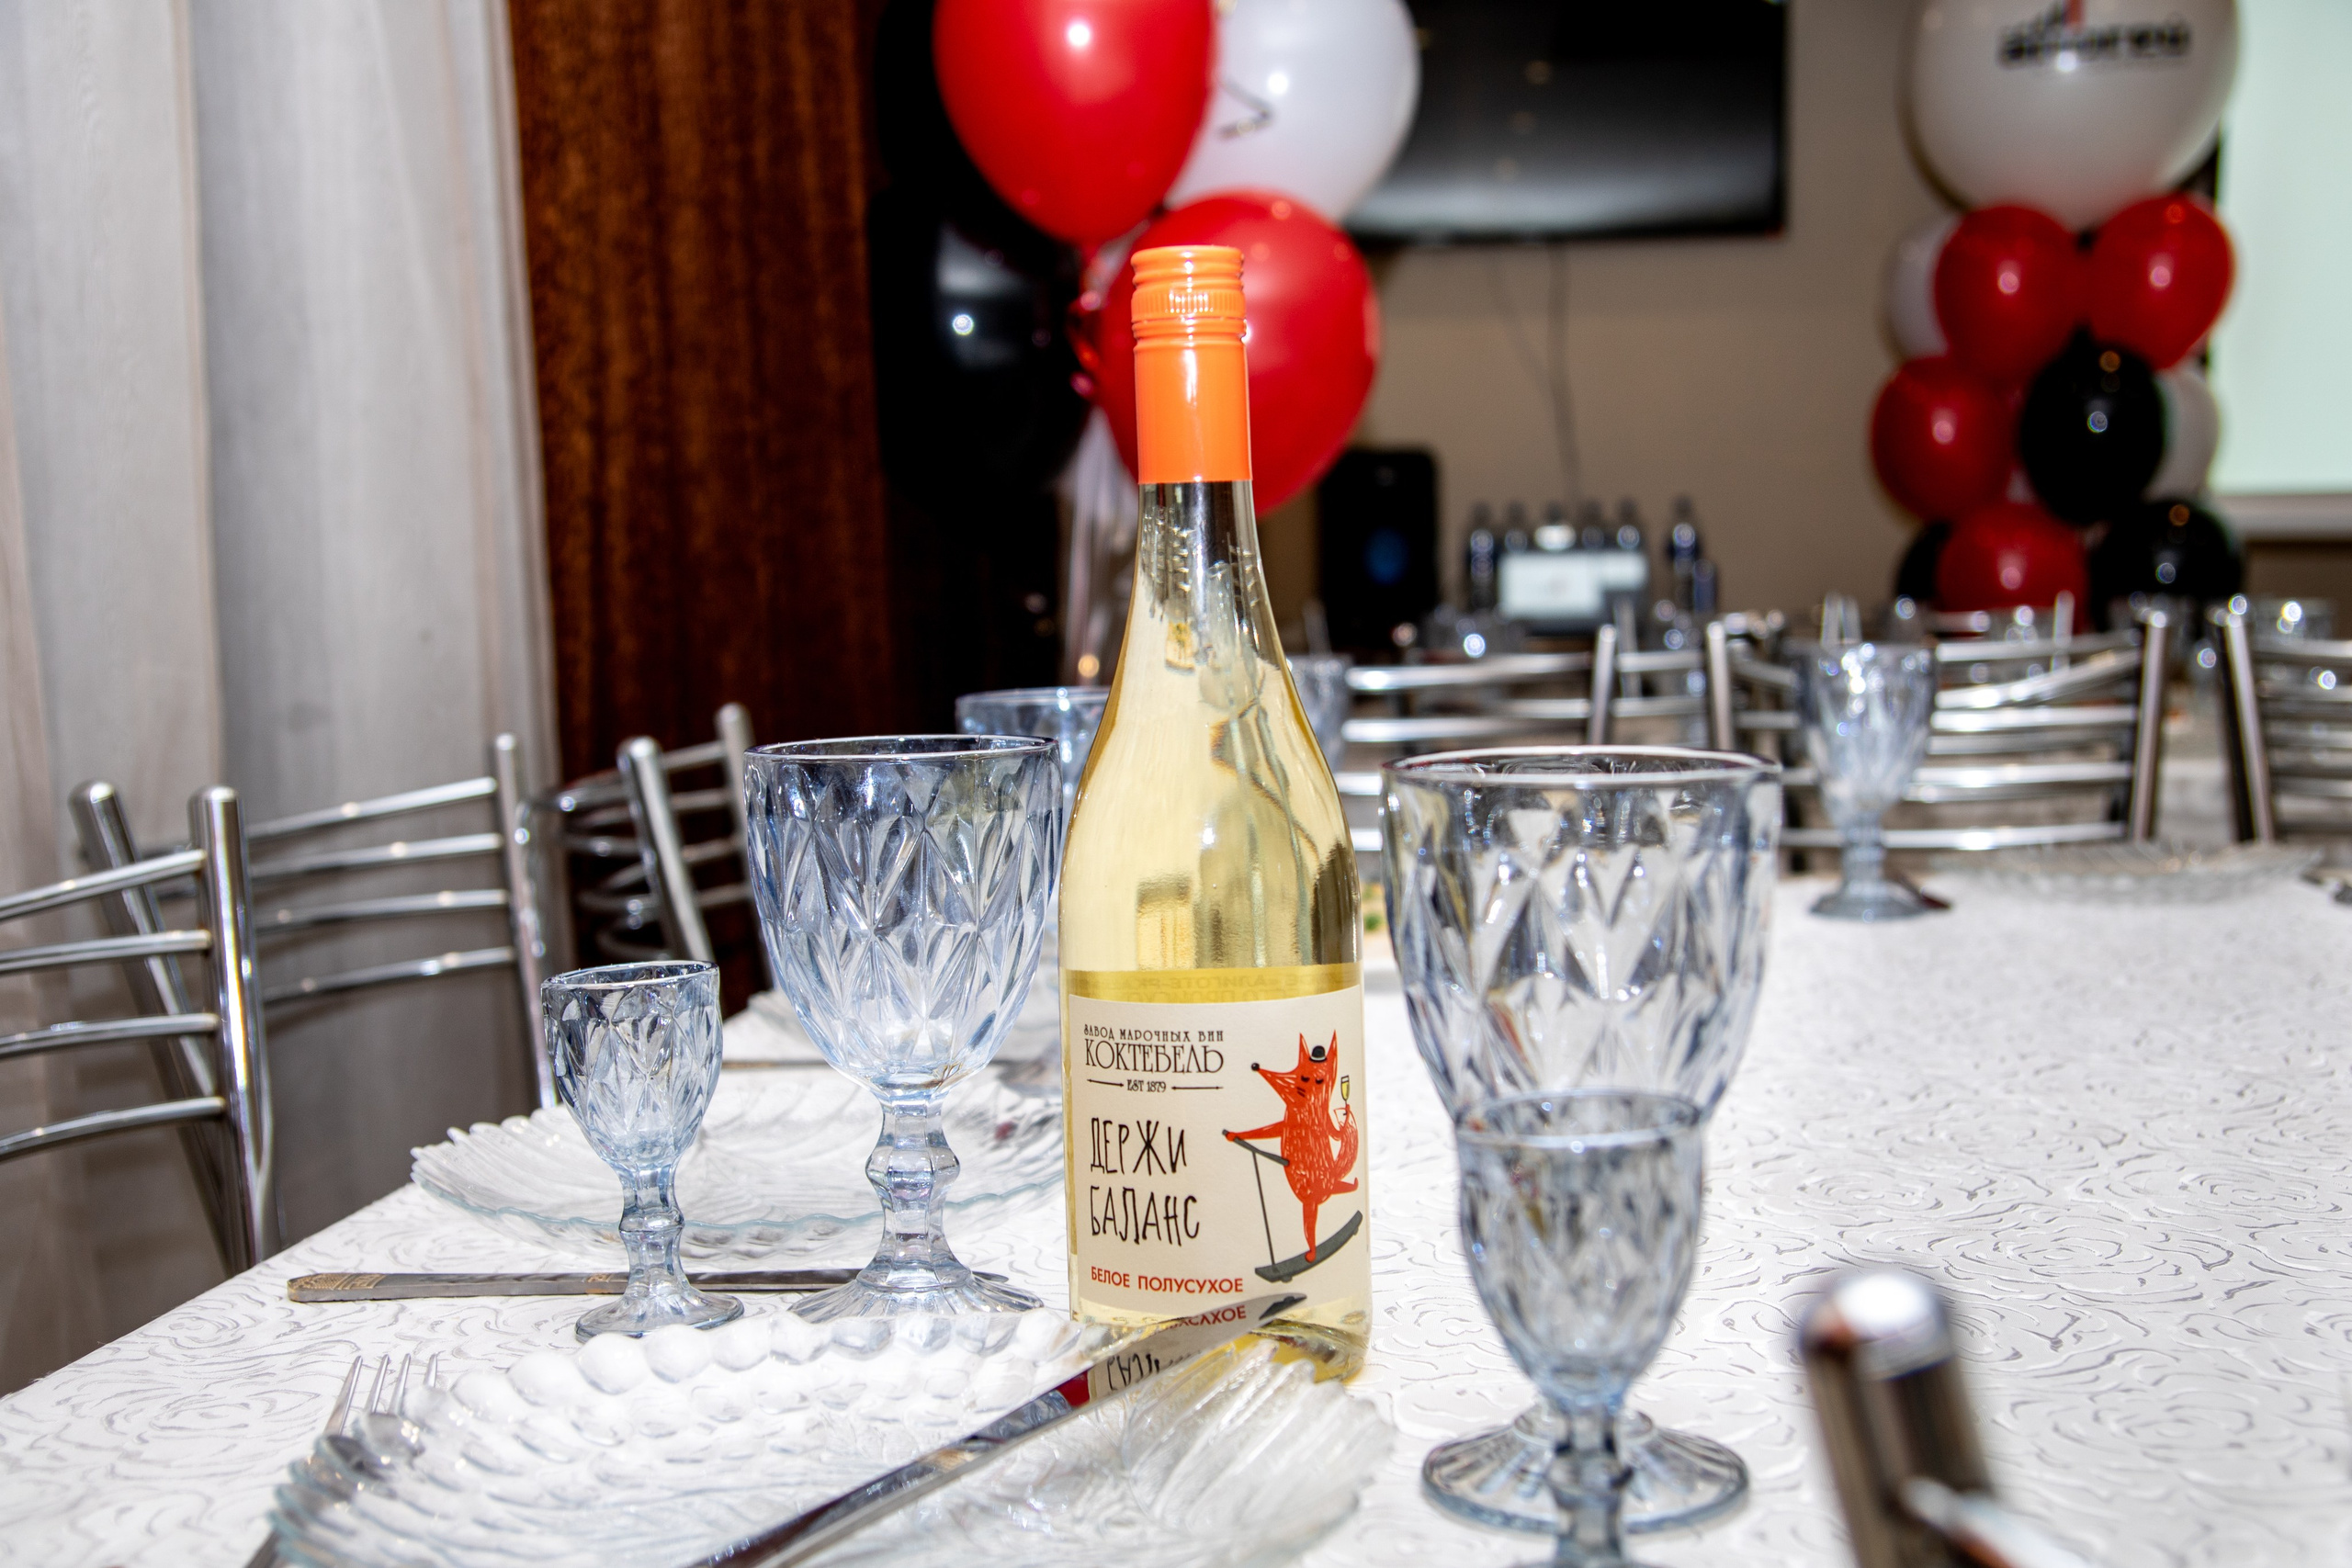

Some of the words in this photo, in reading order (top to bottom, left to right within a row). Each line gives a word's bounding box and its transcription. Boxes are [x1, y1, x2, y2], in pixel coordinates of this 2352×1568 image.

[1084, 1024, 1114, 1041] ЗАВОД
[1120, 1029, 1191, 1043] МАРОЧНЫХ
[1198, 1030, 1224, 1043] ВИН
[1085, 1038, 1224, 1075] КОКТЕБЕЛЬ
[1126, 1078, 1145, 1092] EST
[1147, 1080, 1166, 1093] 1879
[1091, 1117, 1187, 1177] ДЕРЖИ
[1090, 1185, 1200, 1247] БАЛАНС
[1091, 1266, 1131, 1288] БЕЛОЕ
[1137, 1275, 1243, 1294] ПОЛУСУХОЕ
